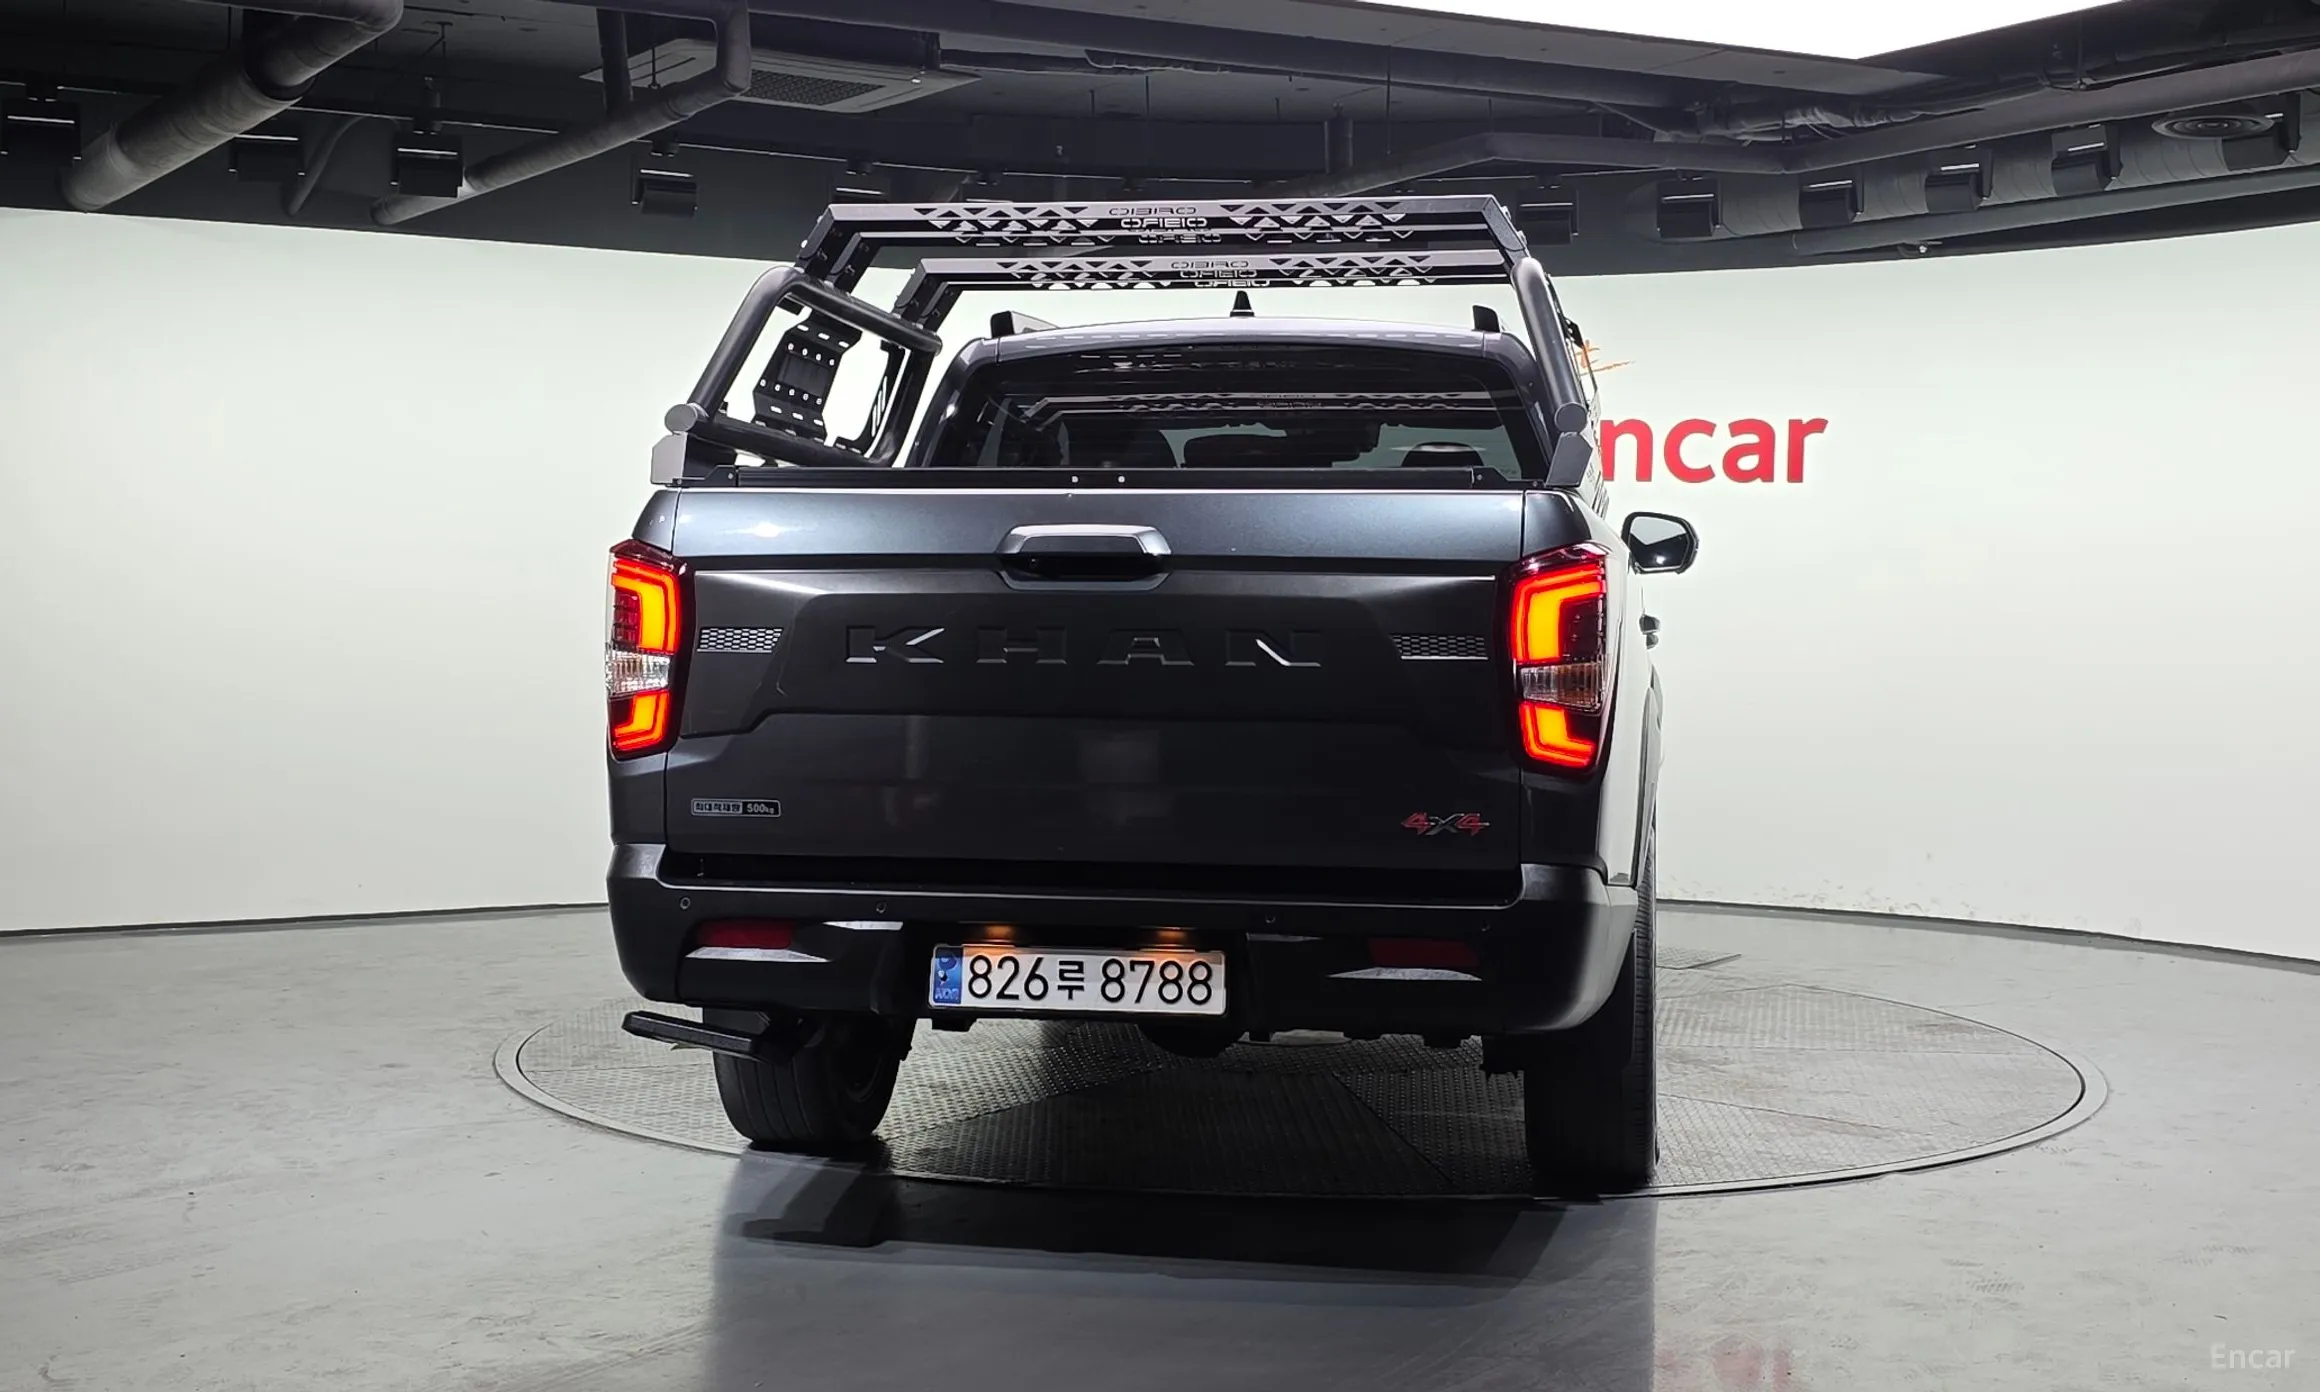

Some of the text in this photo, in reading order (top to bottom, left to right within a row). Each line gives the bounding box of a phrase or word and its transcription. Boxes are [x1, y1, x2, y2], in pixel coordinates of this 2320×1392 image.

[1600, 417, 1828, 484] ncar
[844, 624, 1322, 668] KHAN
[967, 954, 1213, 1006] 826루 8788
